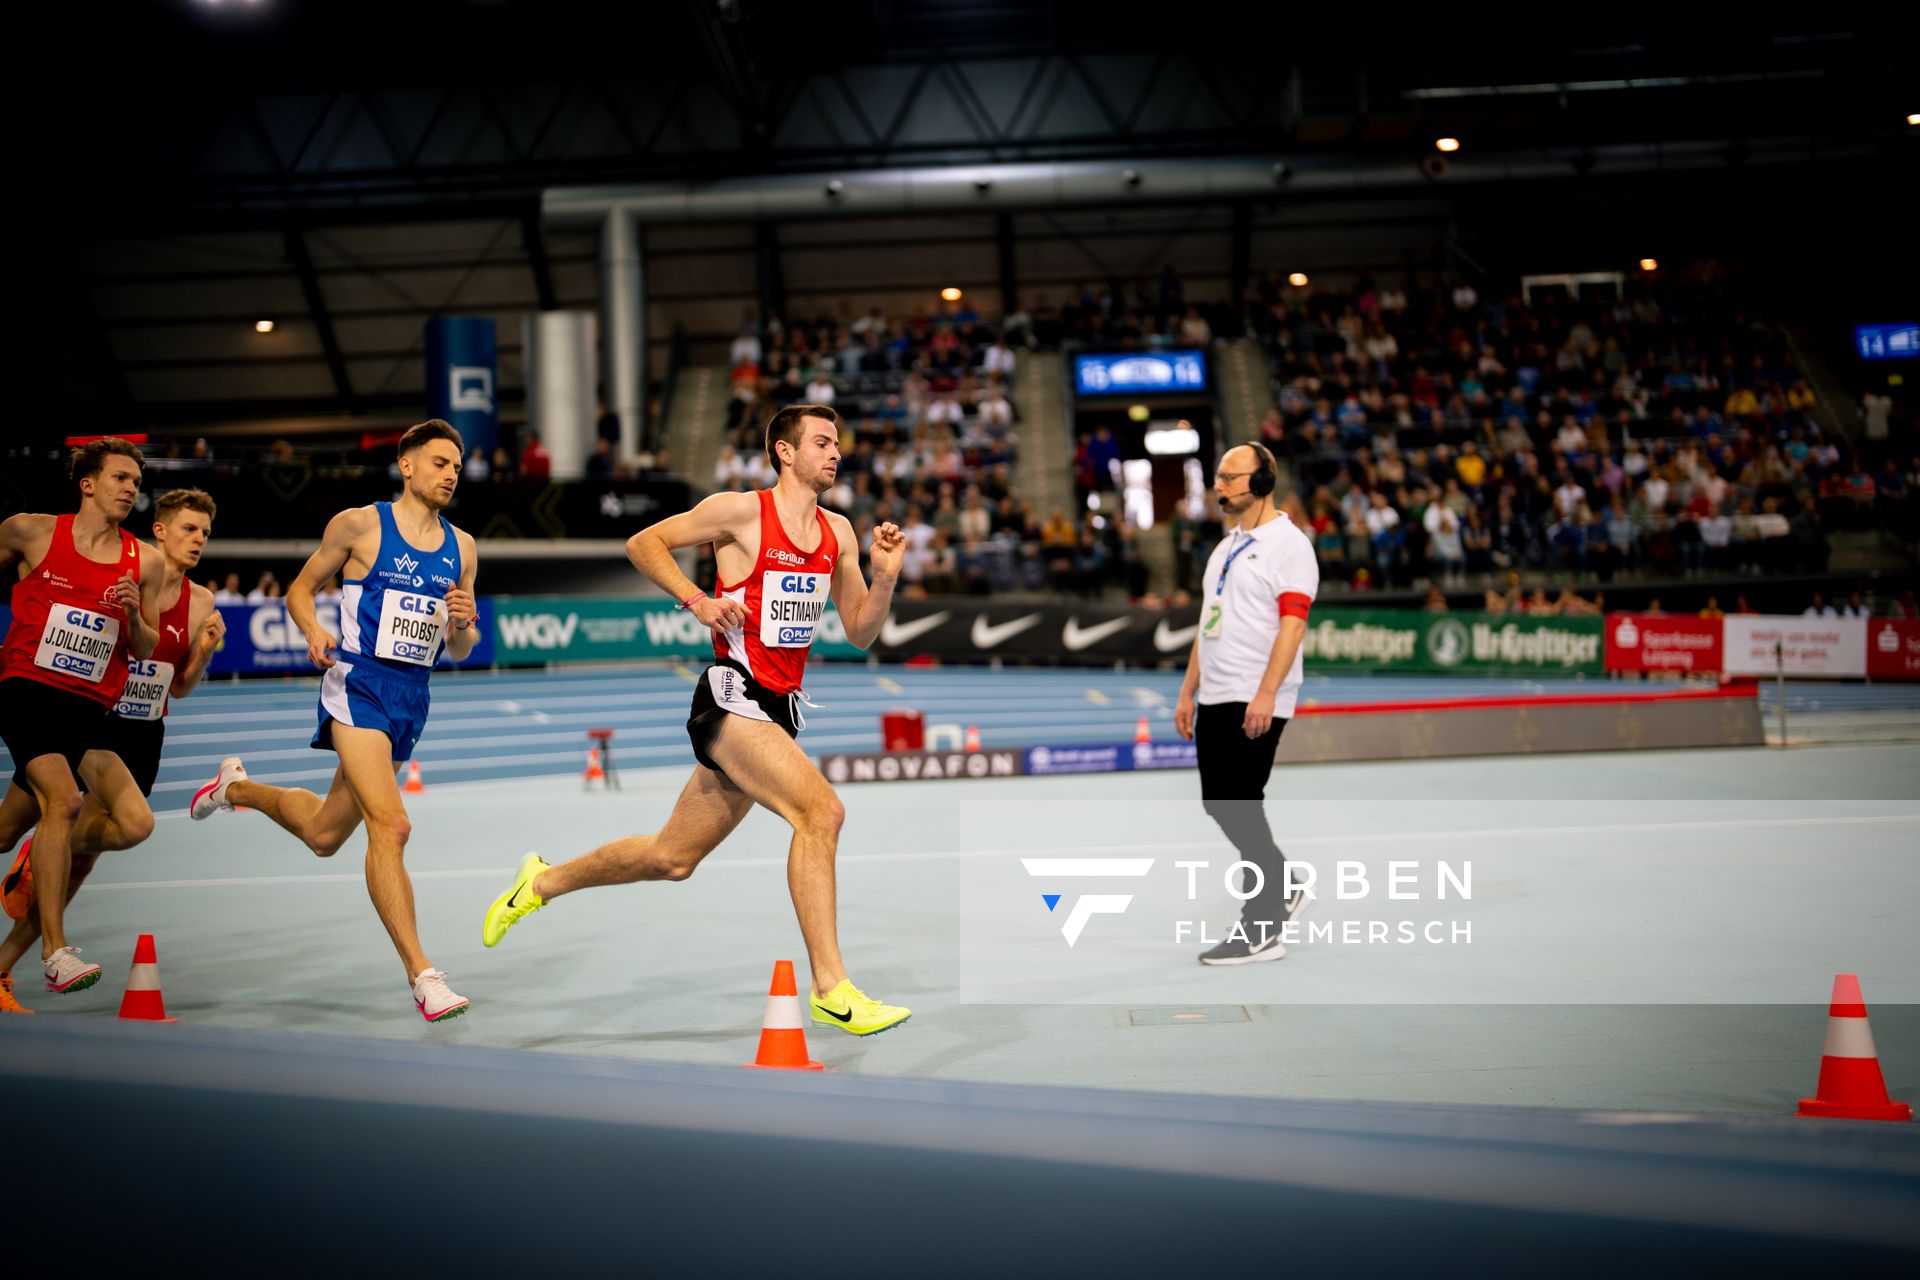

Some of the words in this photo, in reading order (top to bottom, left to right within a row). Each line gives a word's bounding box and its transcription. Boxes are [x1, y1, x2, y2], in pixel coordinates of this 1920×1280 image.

[778, 550, 805, 565] Brillux
[770, 600, 824, 622] SIETMANN
[391, 616, 439, 643] PROBST
[498, 612, 578, 649] WGV
[45, 626, 113, 661] J.DILLEMUTH
[1643, 630, 1714, 651] Sparkasse
[70, 659, 93, 672] PLAN
[1642, 649, 1694, 670] Leipzig
[131, 704, 150, 712] PLAN
[853, 753, 1014, 782] NOVAFON
